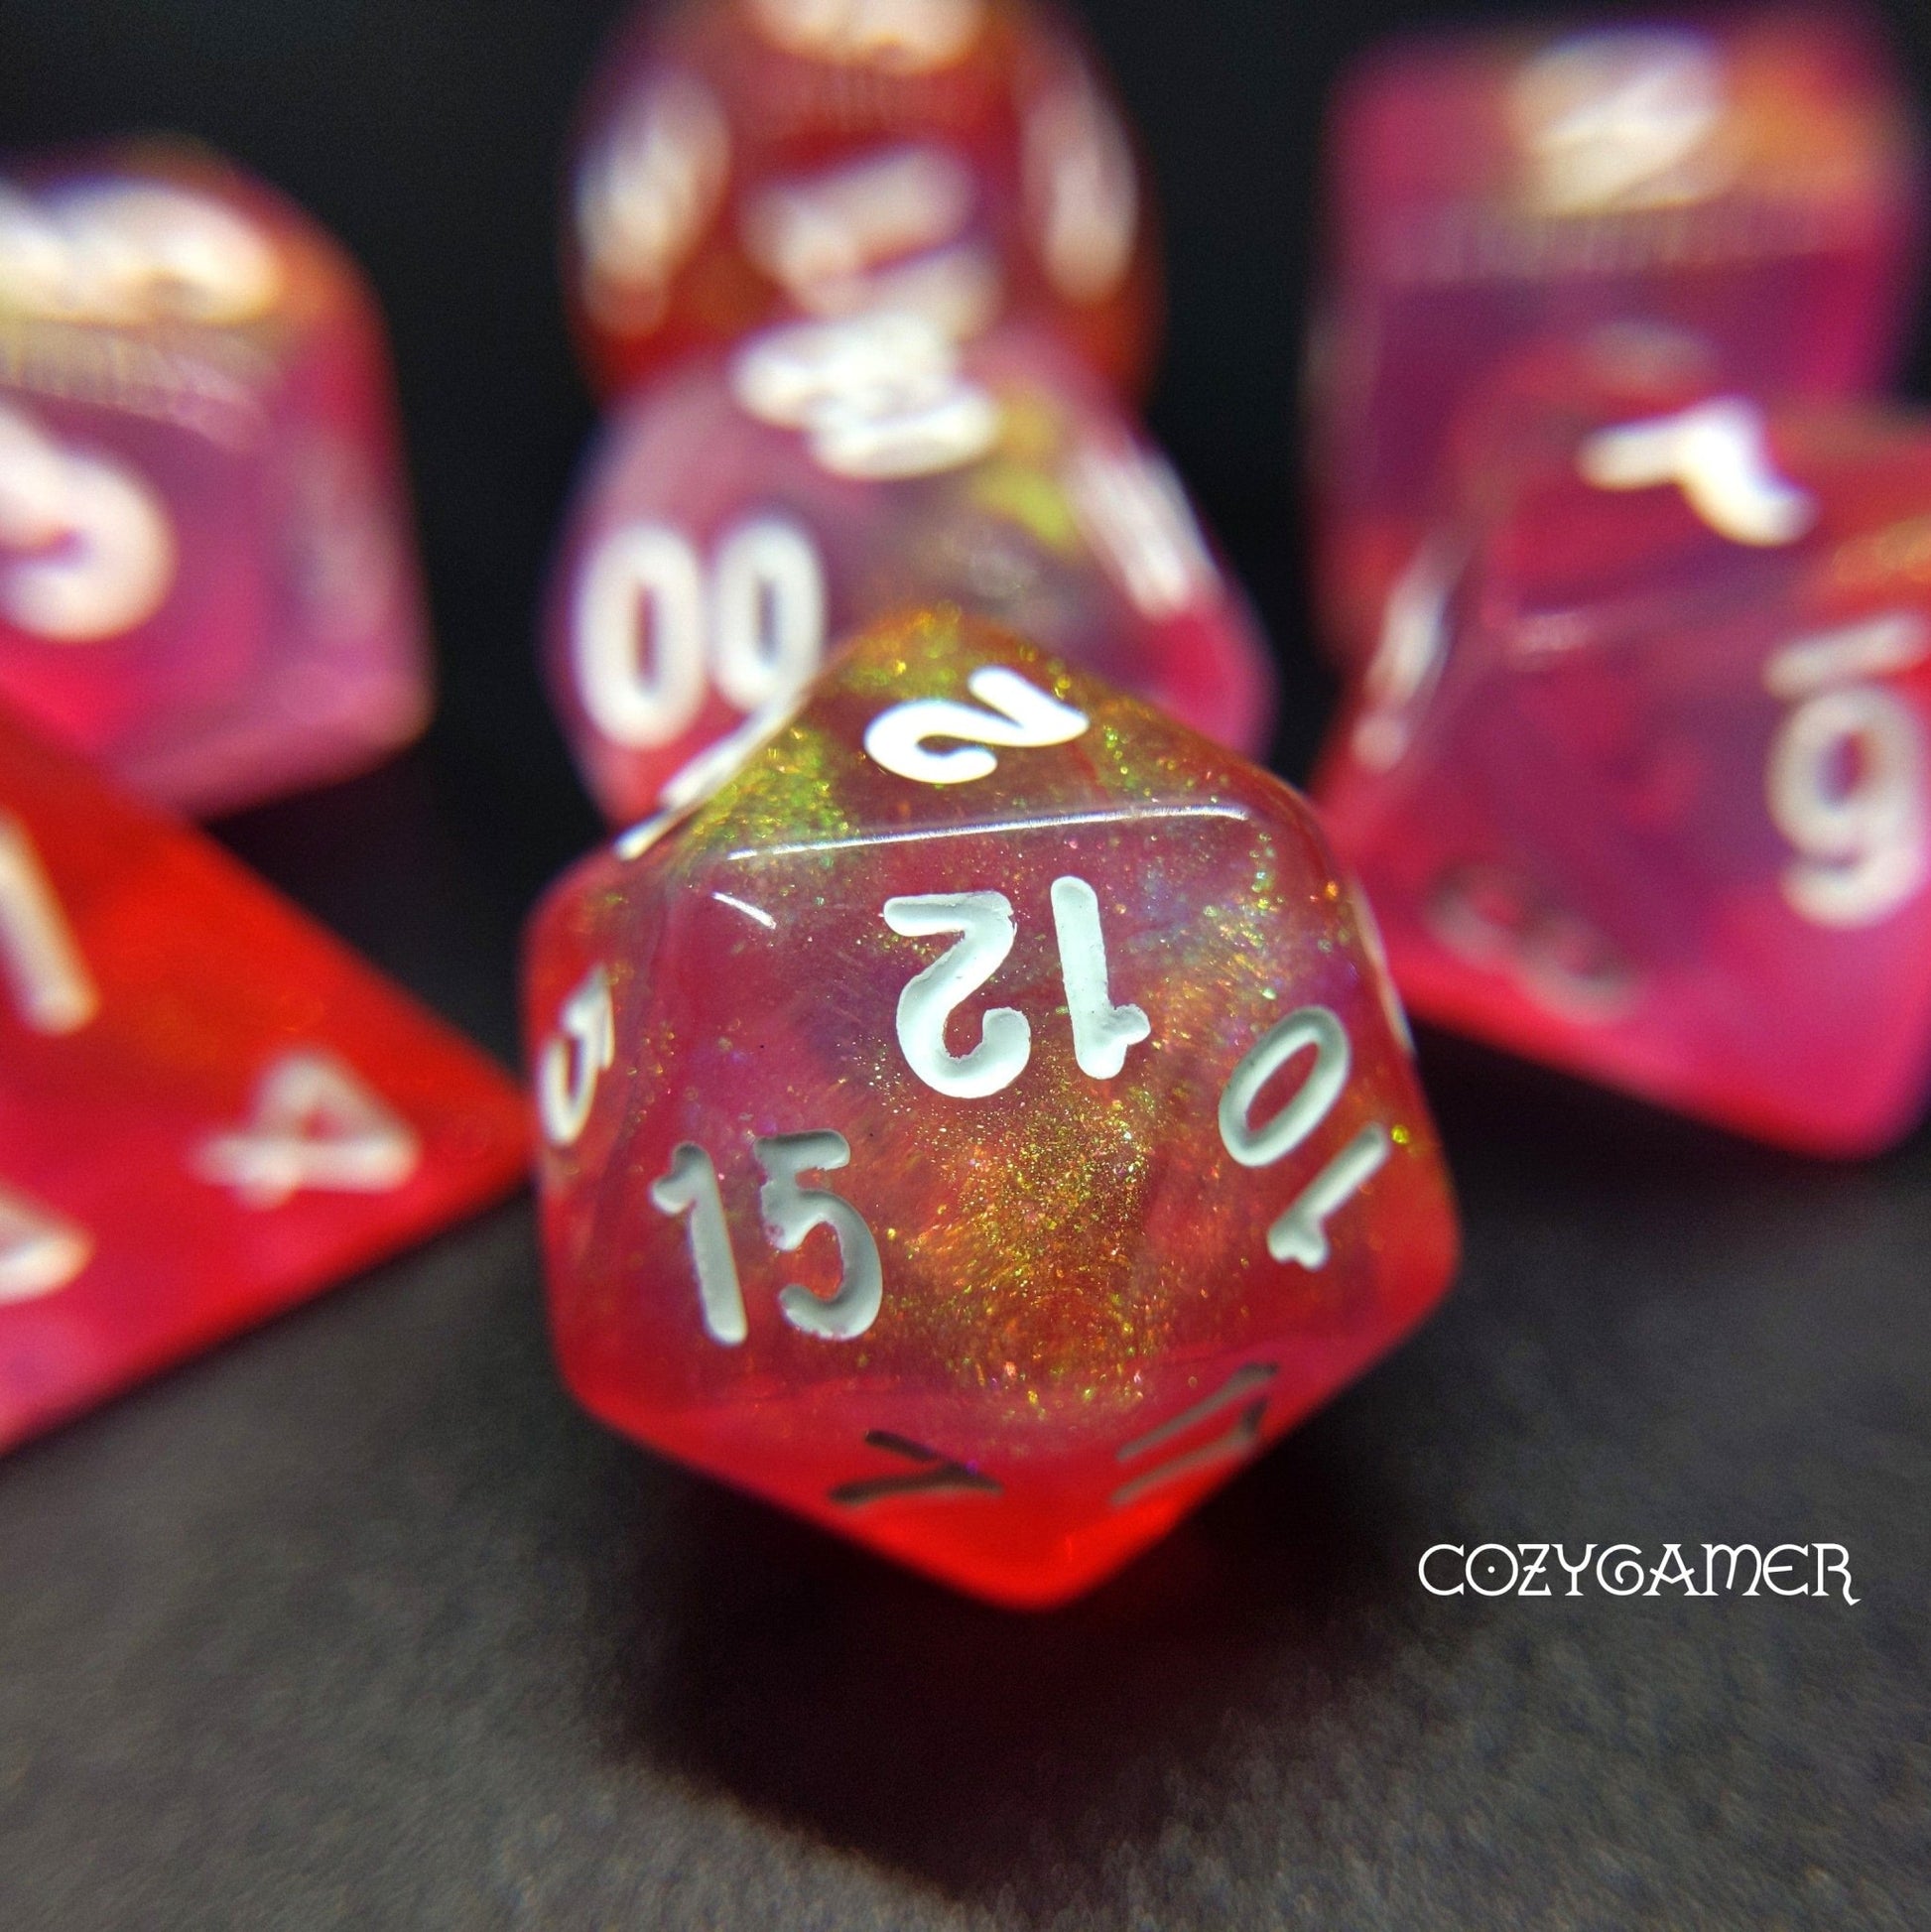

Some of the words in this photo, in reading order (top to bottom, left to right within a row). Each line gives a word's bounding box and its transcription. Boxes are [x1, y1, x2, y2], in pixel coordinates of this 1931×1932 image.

[576, 516, 826, 748] 00
[863, 666, 1090, 784] 2
[881, 875, 1152, 1099] 12
[651, 1129, 884, 1347] 15
[1218, 1006, 1387, 1271] 10
